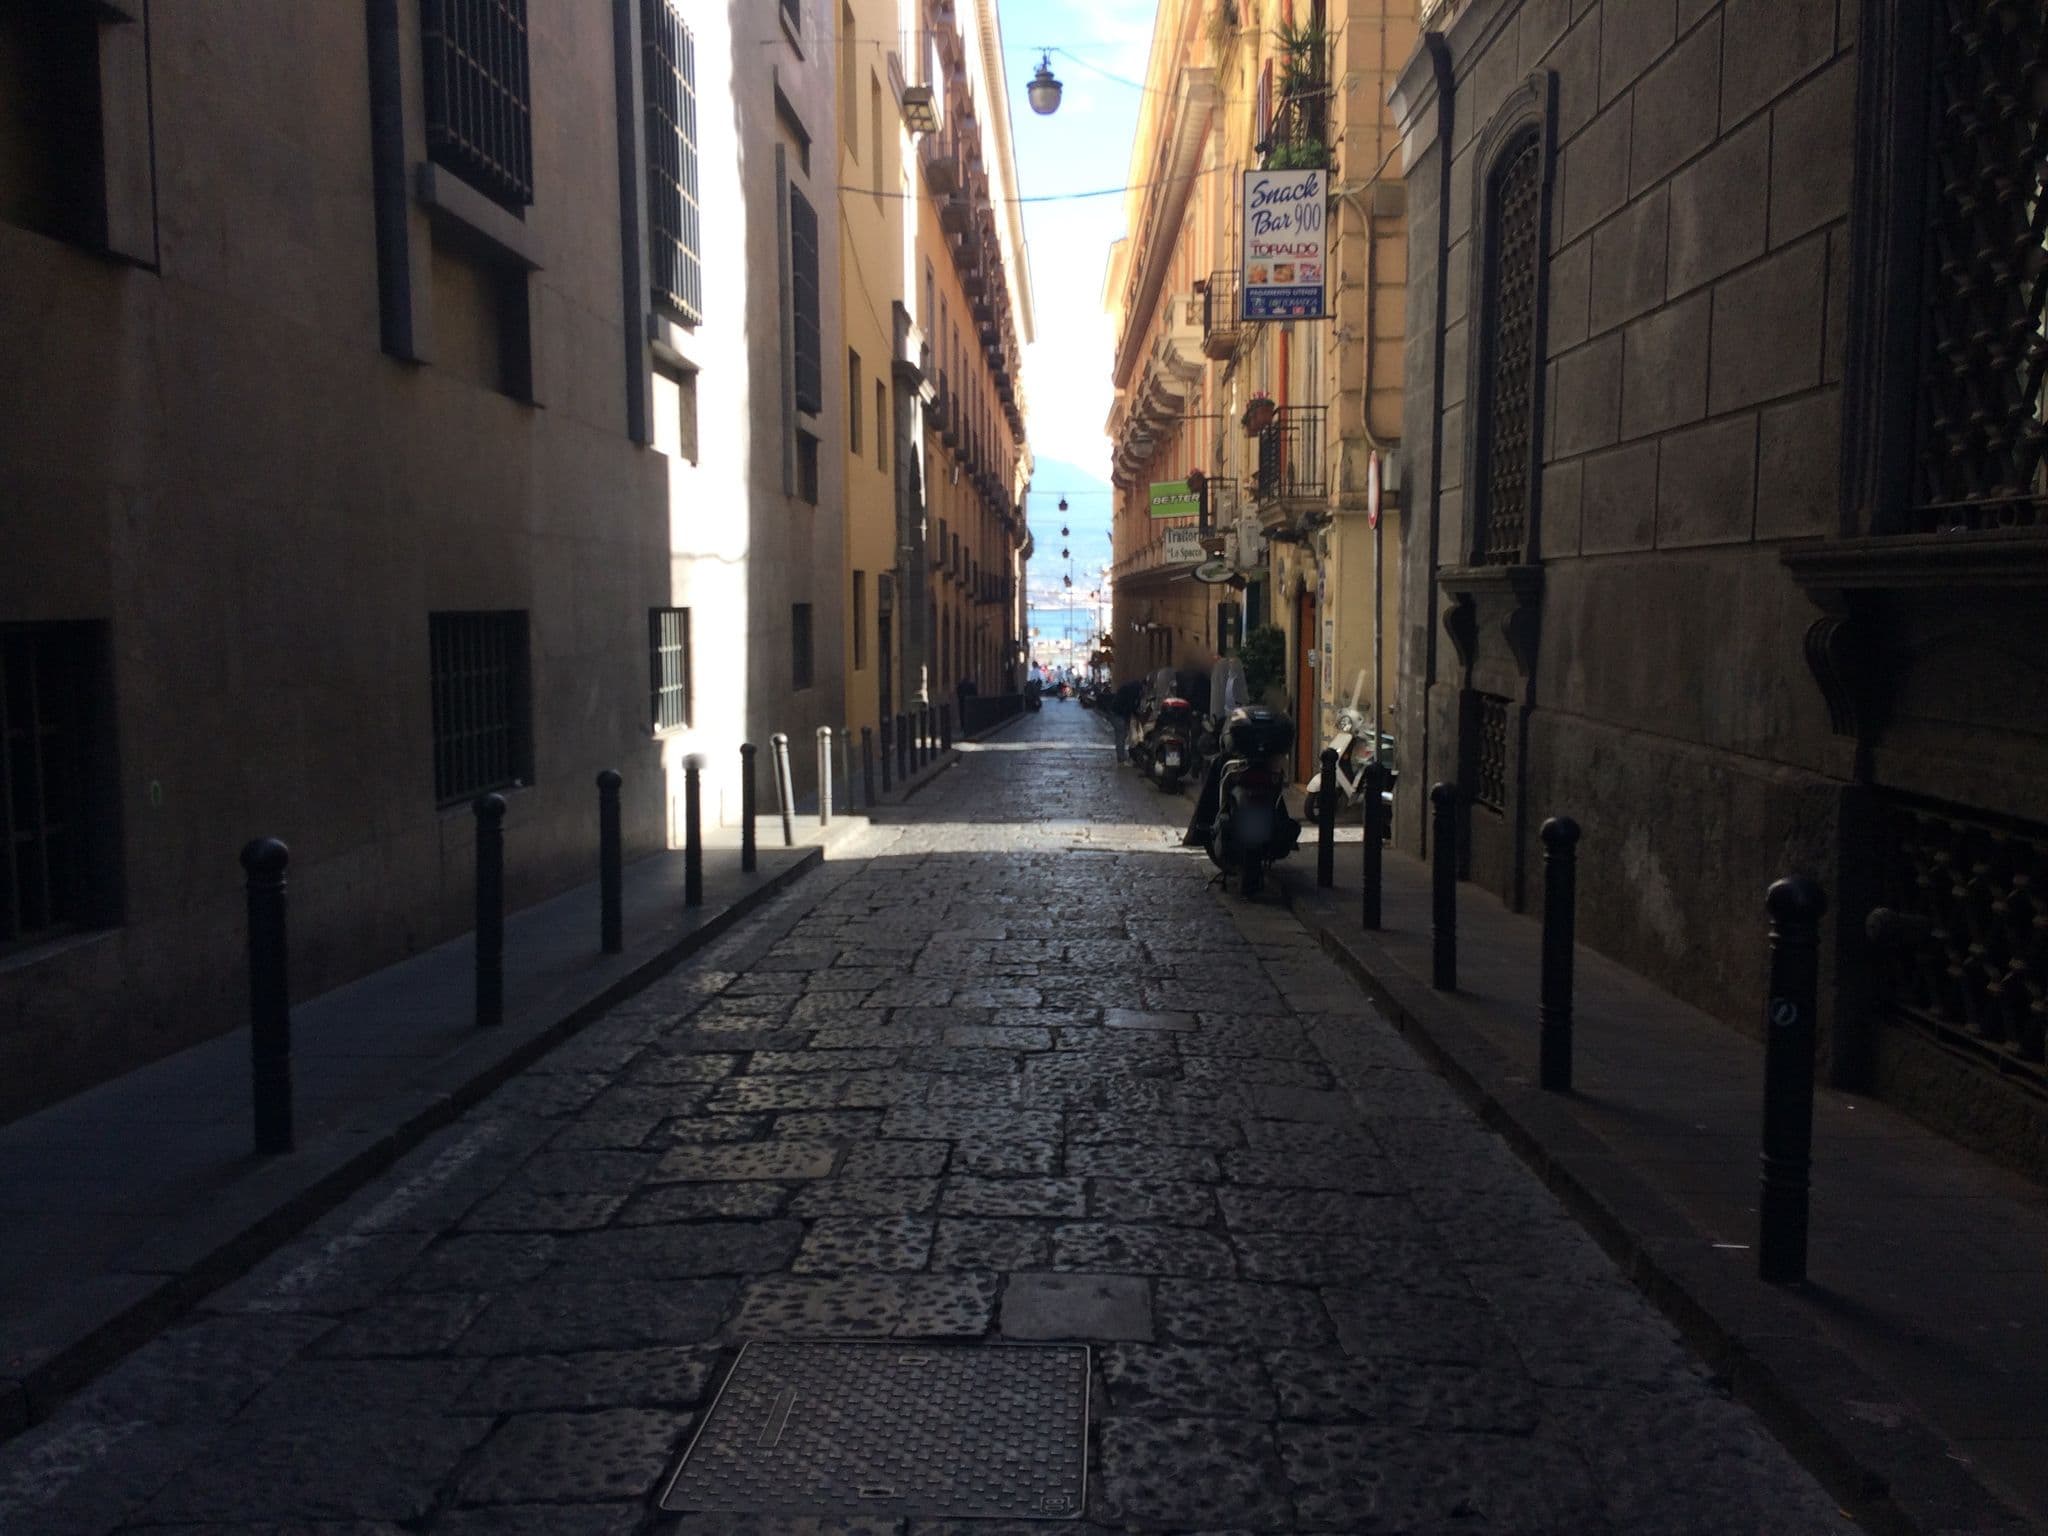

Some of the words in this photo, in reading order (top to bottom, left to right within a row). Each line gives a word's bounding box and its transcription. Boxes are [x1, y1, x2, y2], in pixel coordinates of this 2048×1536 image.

[1251, 172, 1320, 208] Snack
[1251, 210, 1292, 237] Bar
[1295, 202, 1321, 237] 900
[1152, 493, 1200, 505] BETTER
